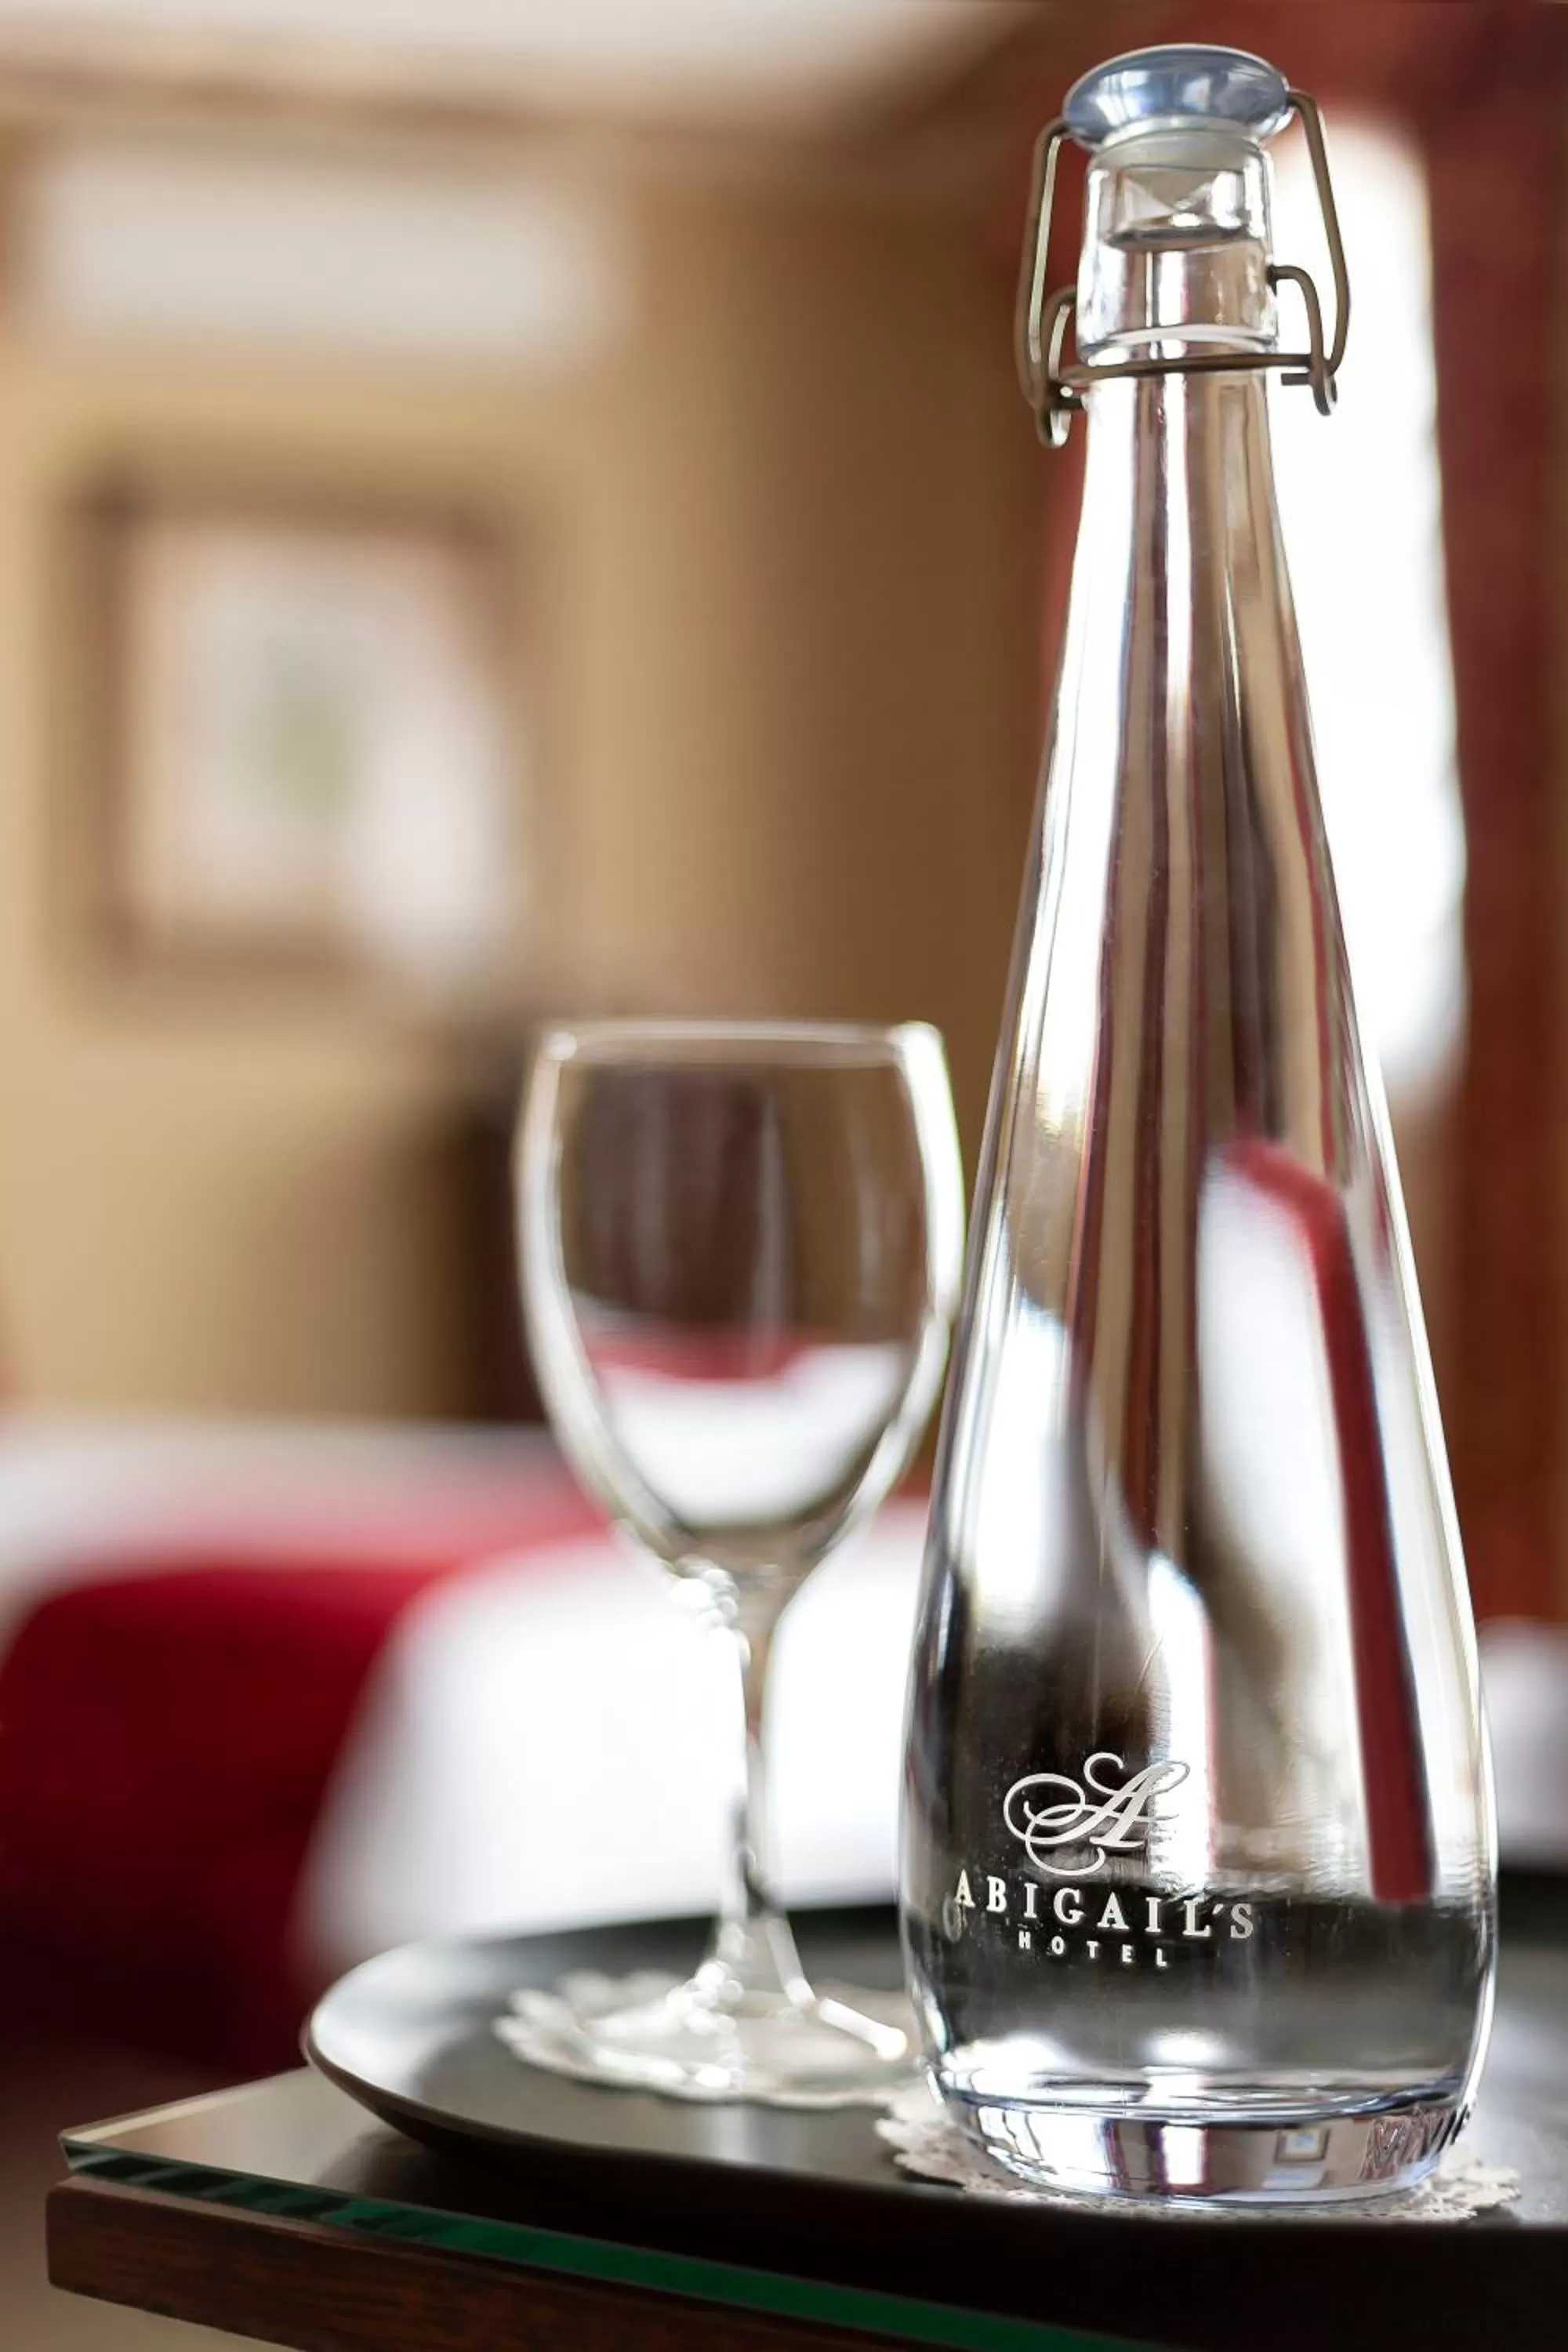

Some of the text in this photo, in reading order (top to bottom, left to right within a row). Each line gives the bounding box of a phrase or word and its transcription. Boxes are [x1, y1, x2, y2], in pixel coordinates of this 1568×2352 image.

[1003, 1752, 1191, 1876] A
[953, 1869, 1254, 1940] ABIGAIL'S
[1018, 1930, 1170, 1968] HOTEL
